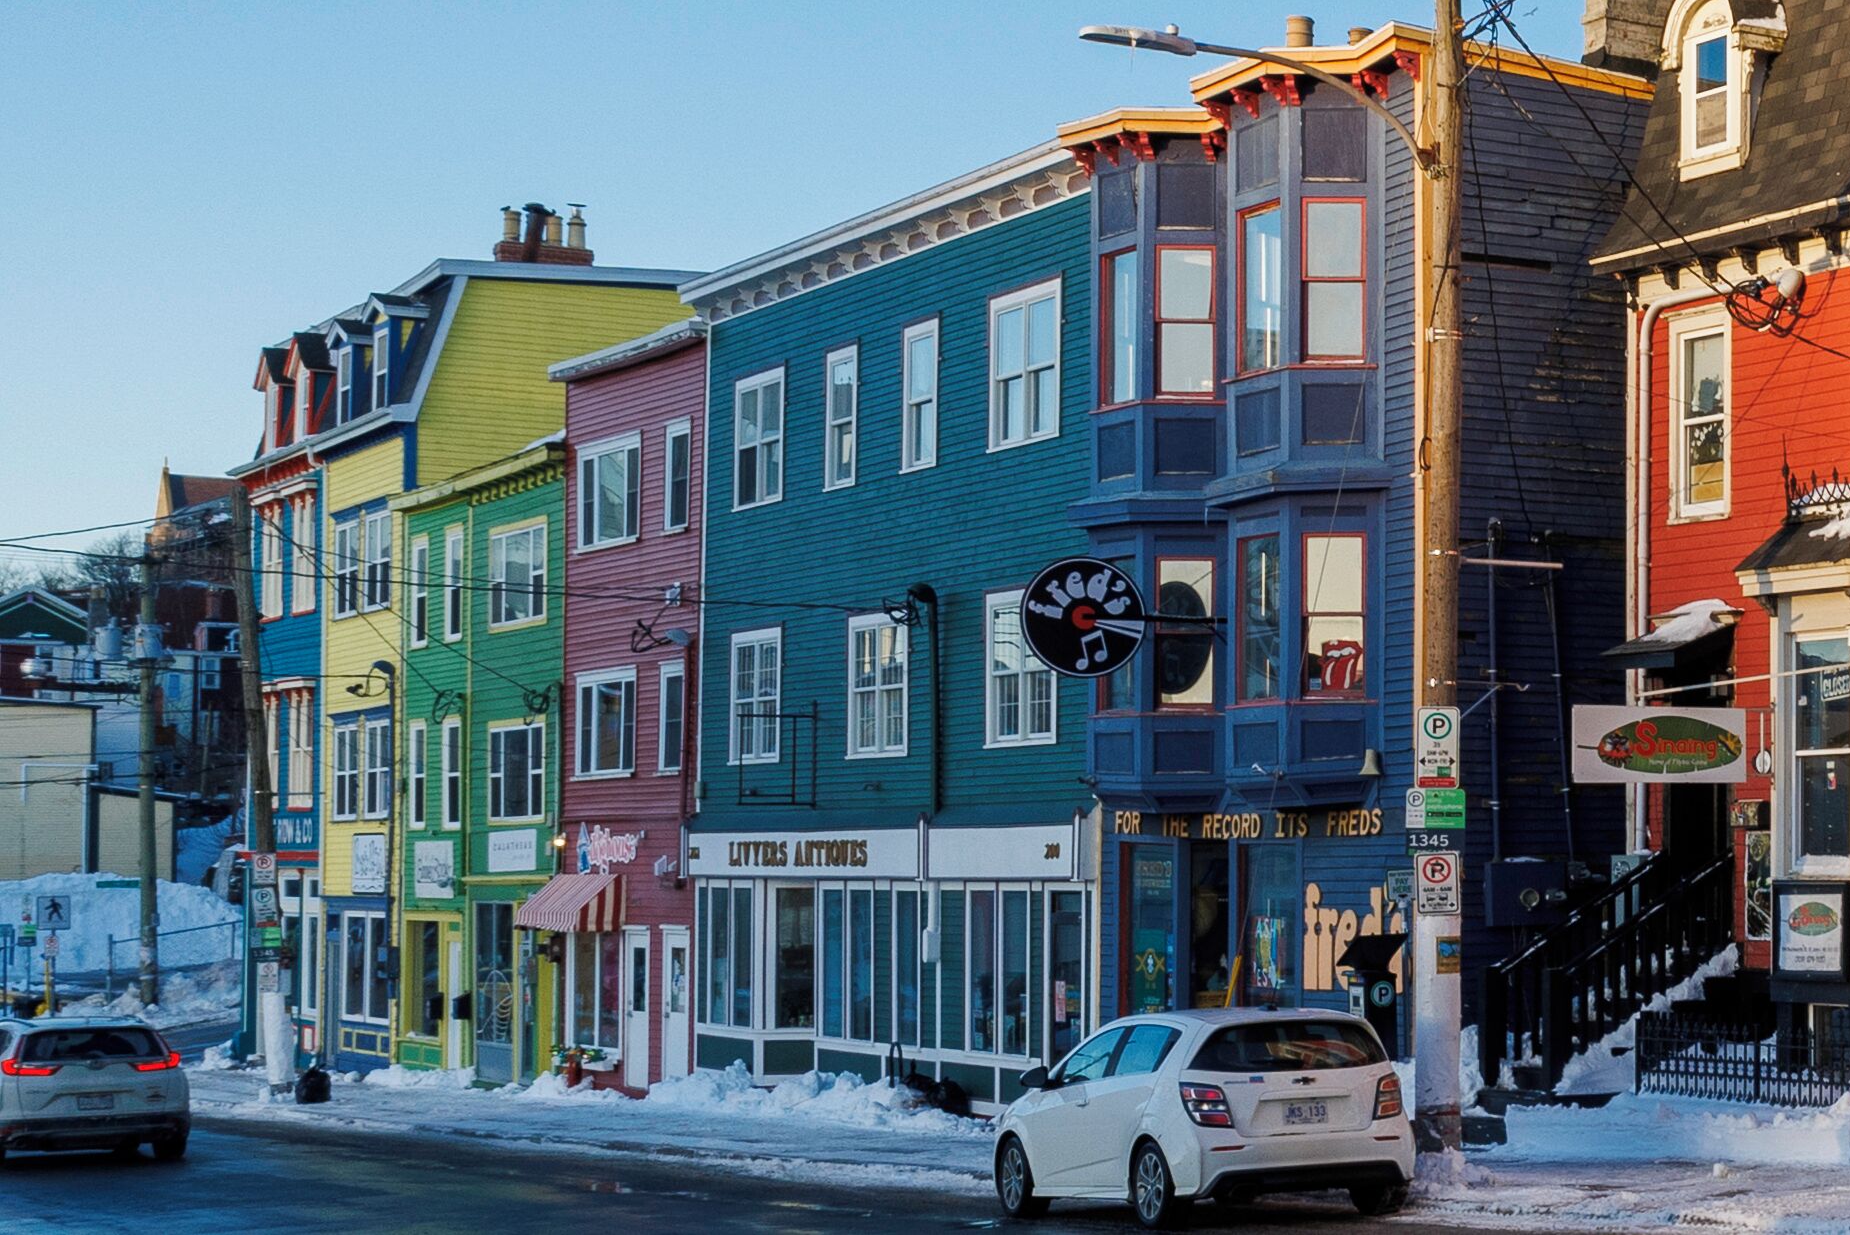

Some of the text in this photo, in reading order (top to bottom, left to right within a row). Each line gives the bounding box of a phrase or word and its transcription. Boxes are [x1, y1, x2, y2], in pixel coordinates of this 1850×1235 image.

[1028, 568, 1132, 620] fred's
[1115, 811, 1142, 834] FOR
[1162, 814, 1190, 837] THE
[1202, 813, 1262, 839] RECORD
[1275, 812, 1309, 837] ITS
[1327, 808, 1383, 837] FREDS
[728, 841, 788, 868] LIVYERS
[793, 839, 869, 868] ANTIQUES
[1409, 834, 1450, 847] 1345
[1308, 1105, 1327, 1118] 133
